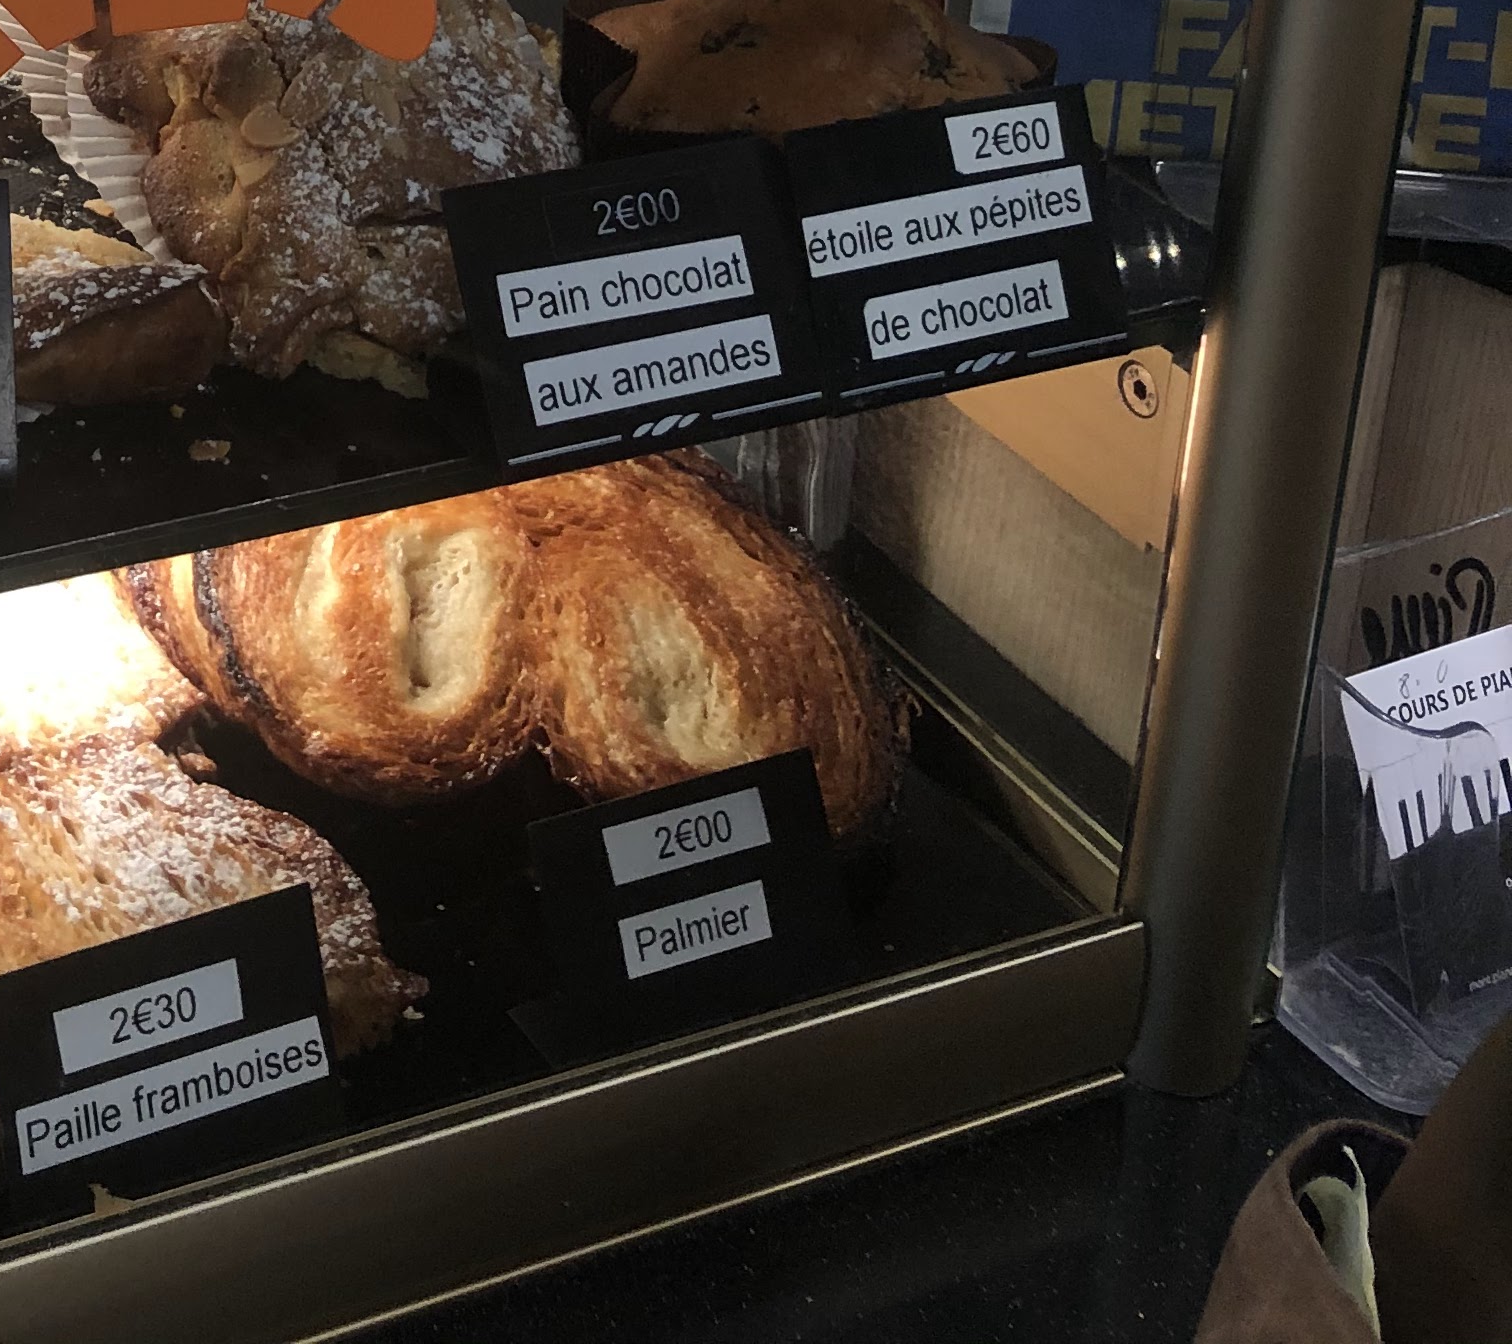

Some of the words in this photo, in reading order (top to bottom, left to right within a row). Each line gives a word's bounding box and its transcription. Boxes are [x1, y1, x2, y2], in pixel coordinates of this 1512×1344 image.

[972, 115, 1052, 161] 2€60
[592, 188, 682, 237] 2€00
[808, 223, 893, 265] étoile
[905, 213, 962, 243] aux
[970, 183, 1083, 238] pépites
[509, 280, 591, 324] Pain
[601, 252, 747, 309] chocolat
[871, 305, 913, 347] de
[919, 278, 1053, 337] chocolat
[537, 375, 604, 412] aux
[612, 334, 772, 398] amandes
[1386, 688, 1450, 725] COURS
[1452, 679, 1479, 707] DE
[655, 810, 735, 861] 2€00
[633, 899, 753, 964] Palmier
[107, 987, 199, 1047] 2€30
[24, 1102, 124, 1161] Paille
[133, 1036, 326, 1127] framboises
